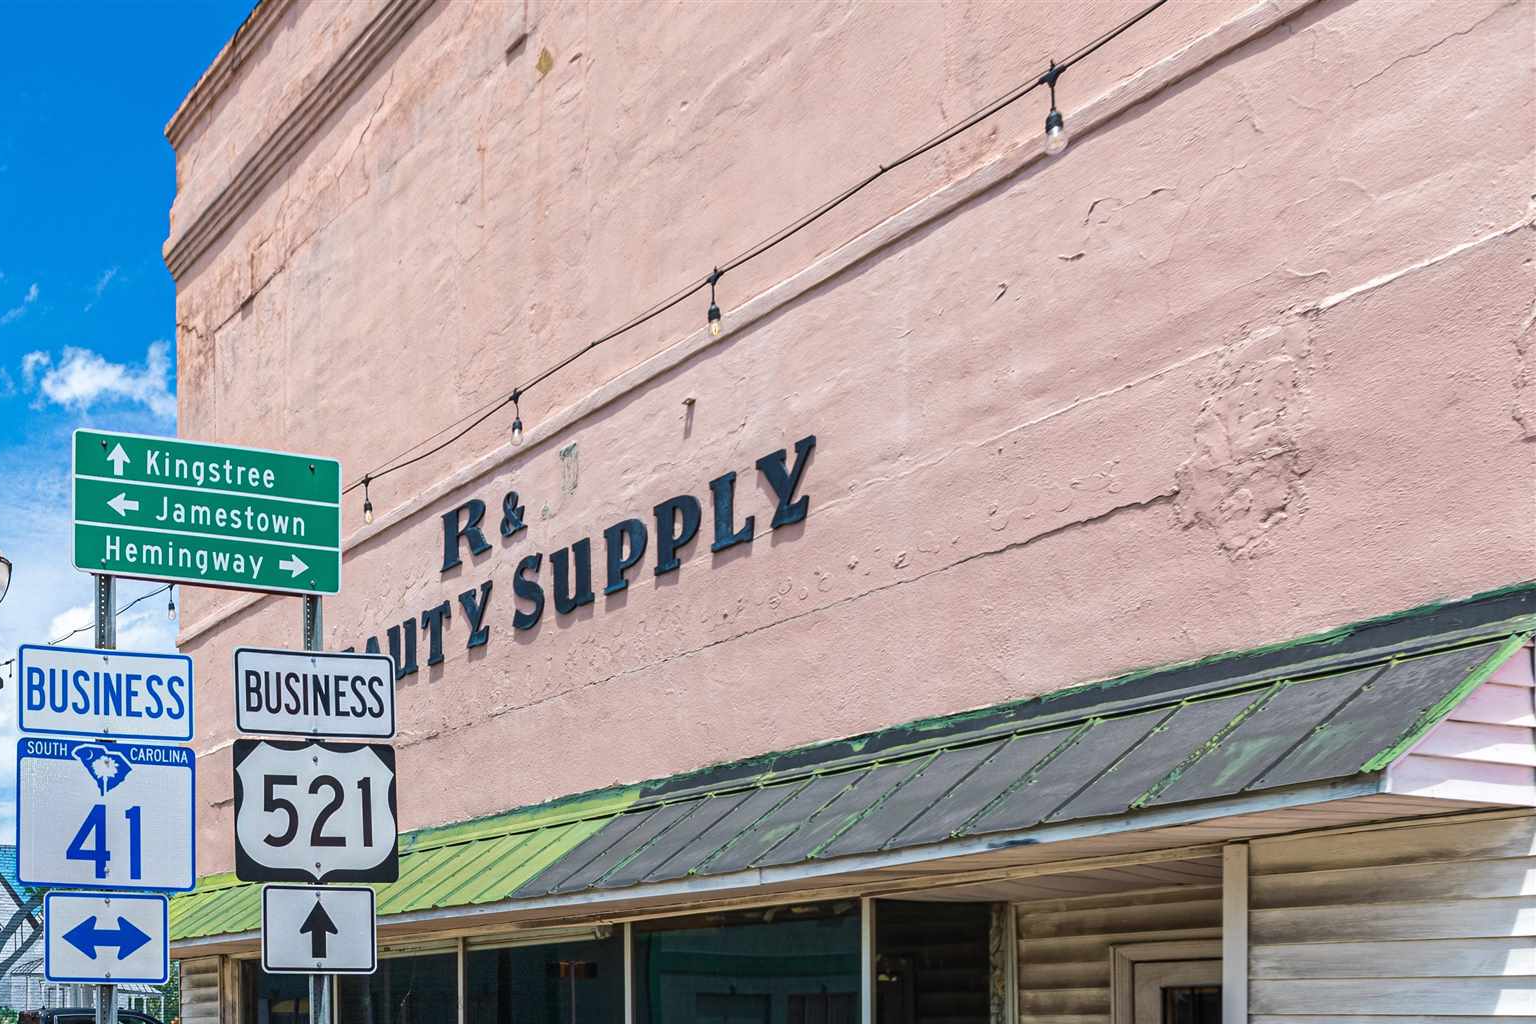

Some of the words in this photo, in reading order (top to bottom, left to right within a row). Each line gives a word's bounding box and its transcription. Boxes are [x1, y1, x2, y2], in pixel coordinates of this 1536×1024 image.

[146, 449, 276, 488] Kingstree
[155, 496, 306, 537] Jamestown
[512, 434, 817, 631] SUPPLY
[104, 535, 264, 579] Hemingway
[26, 666, 185, 720] BUSINESS
[245, 669, 385, 719] BUSINESS
[27, 741, 68, 757] SOUTH
[130, 747, 188, 764] CAROLINA
[263, 775, 374, 848] 521
[66, 804, 142, 880] 41
